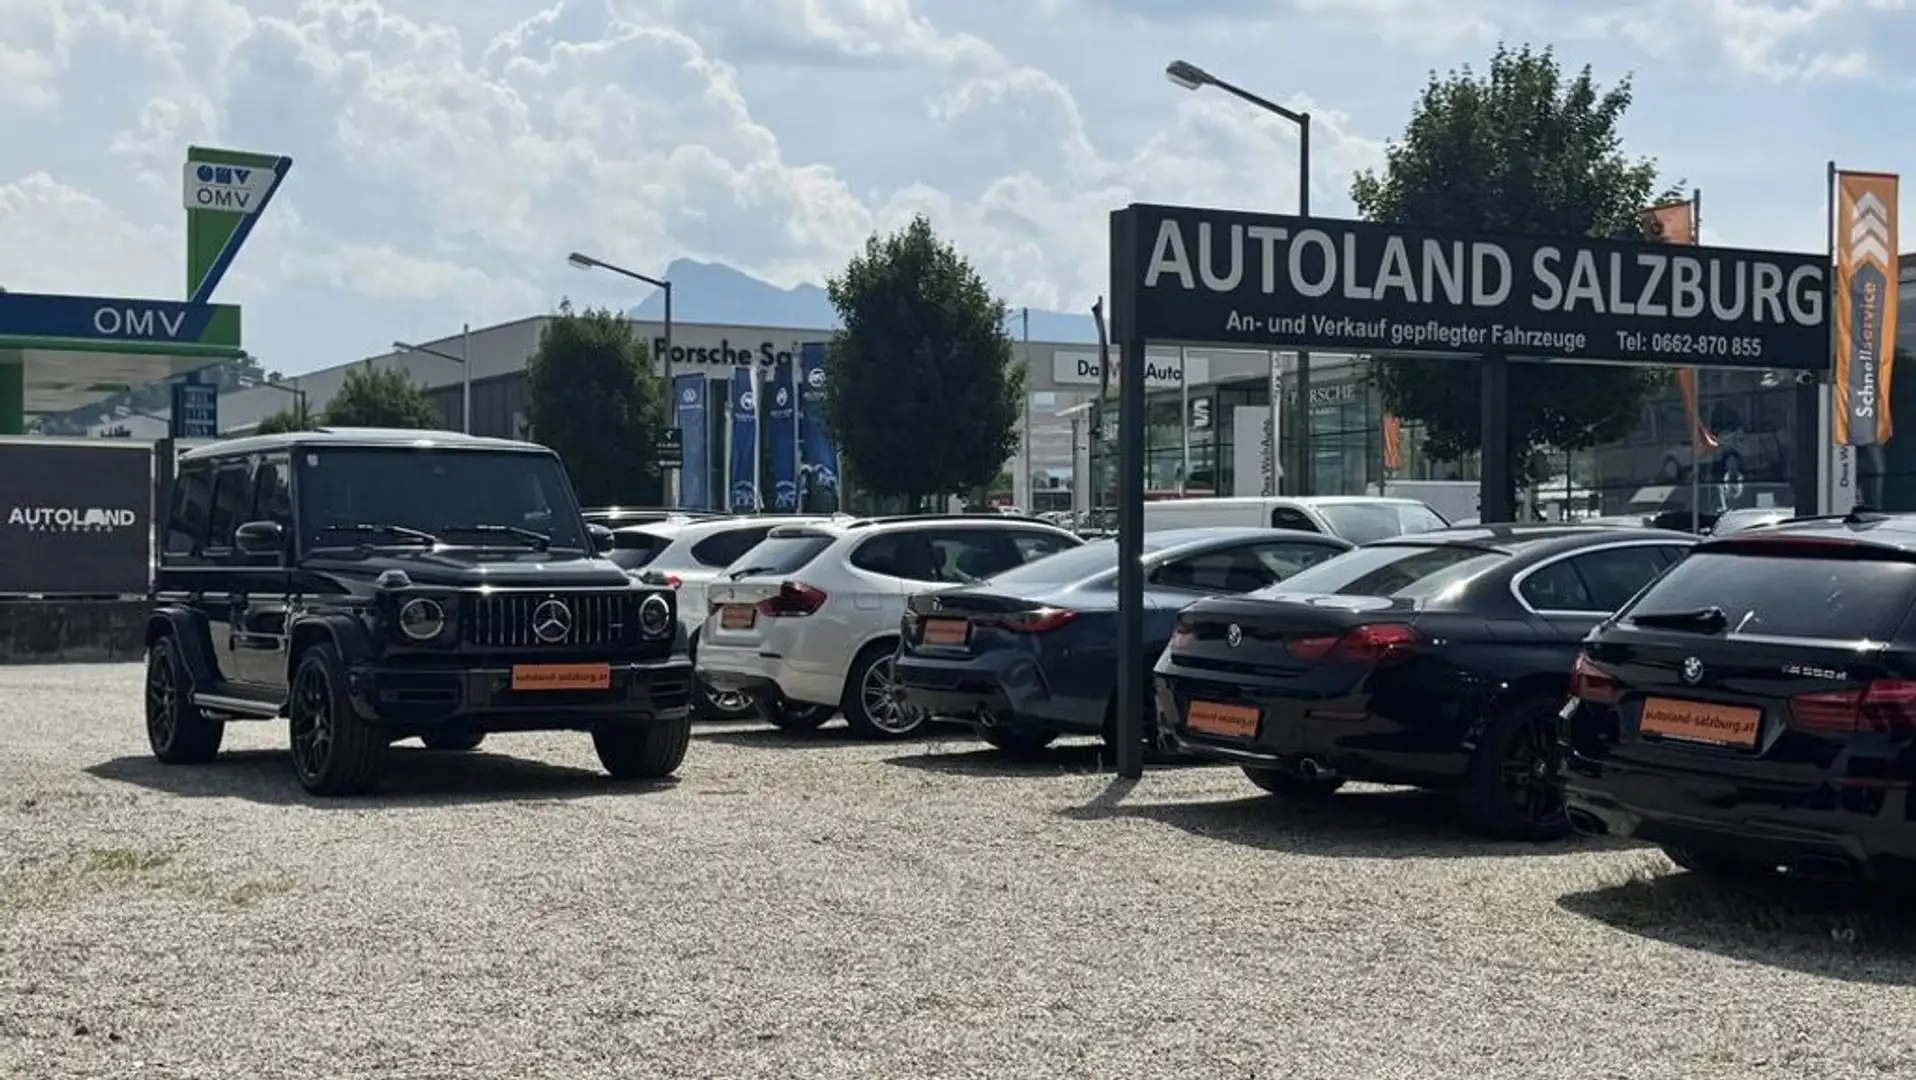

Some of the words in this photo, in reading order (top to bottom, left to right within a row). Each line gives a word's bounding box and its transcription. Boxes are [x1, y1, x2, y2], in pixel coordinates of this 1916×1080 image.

[196, 188, 250, 207] OMV
[1144, 219, 1512, 307] AUTOLAND
[1531, 246, 1823, 326] SALZBURG
[94, 307, 186, 337] OMV
[1226, 310, 1263, 332] An-
[1268, 314, 1306, 335] und
[1311, 314, 1387, 339] Verkauf
[1391, 318, 1488, 347] gepflegter
[1492, 324, 1586, 352] Fahrzeuge
[653, 337, 752, 365] Porsche
[1617, 331, 1648, 351] Tel:
[1651, 332, 1727, 356] 0662-870
[1732, 337, 1762, 357] 855
[1855, 282, 1876, 419] Schnellservice
[1077, 359, 1102, 376] Da
